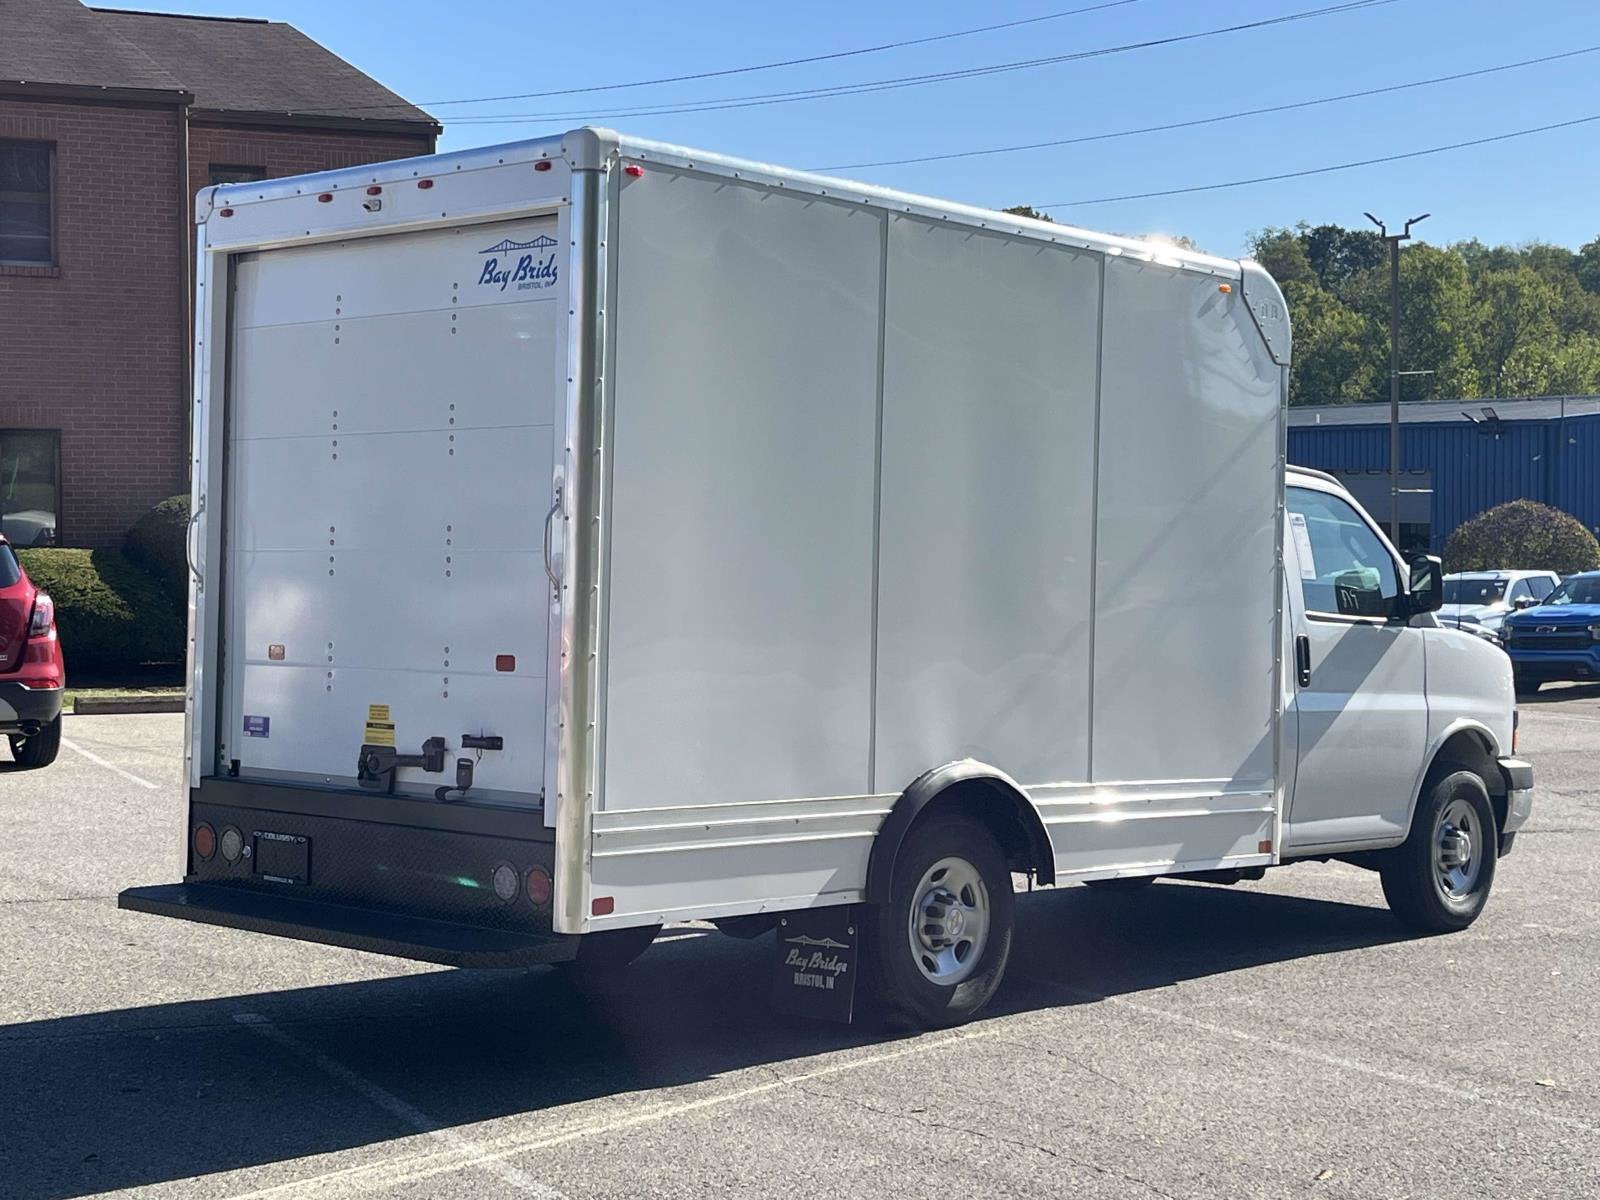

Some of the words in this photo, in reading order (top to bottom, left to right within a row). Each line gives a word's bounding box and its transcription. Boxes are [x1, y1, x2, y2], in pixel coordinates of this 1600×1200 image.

[478, 258, 511, 291] Bay
[511, 253, 558, 285] Bridg
[784, 948, 808, 971] Bay
[808, 952, 848, 976] Bridge
[793, 972, 825, 989] BRISTOL,
[826, 976, 835, 989] IN
